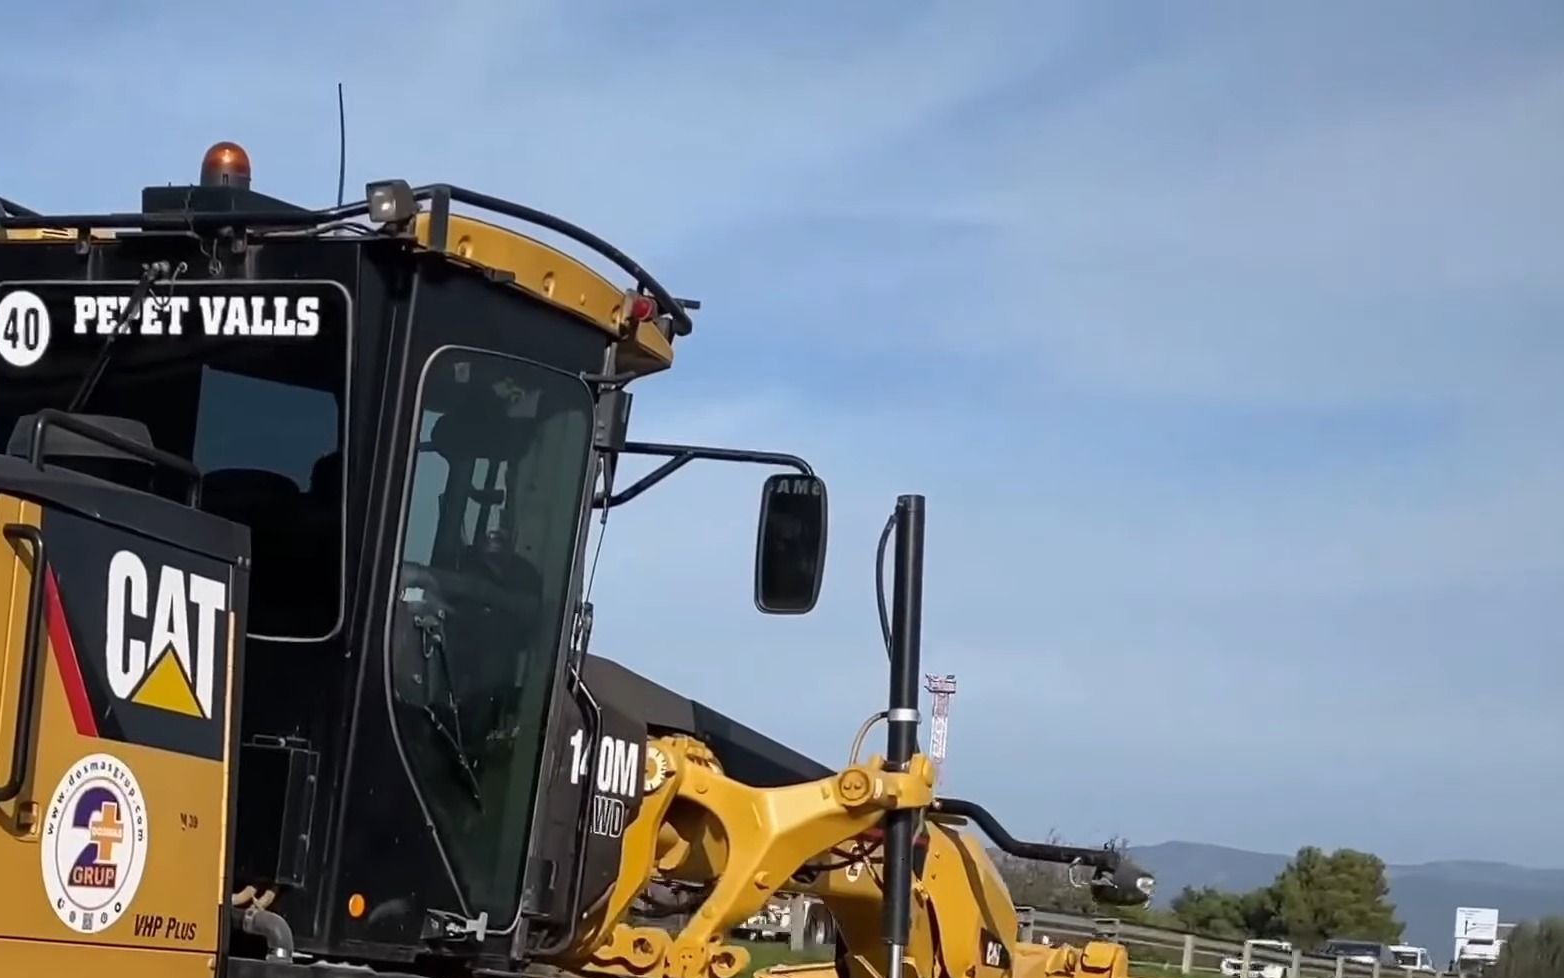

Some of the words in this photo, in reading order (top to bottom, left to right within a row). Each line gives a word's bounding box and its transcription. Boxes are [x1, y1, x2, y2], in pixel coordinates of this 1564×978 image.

[3, 307, 38, 351] 40
[73, 295, 191, 336] PEPET
[199, 295, 321, 337] VALLS
[105, 549, 227, 720] CAT
[589, 794, 626, 839] WD
[72, 866, 116, 886] GRUP
[134, 913, 164, 939] VHP
